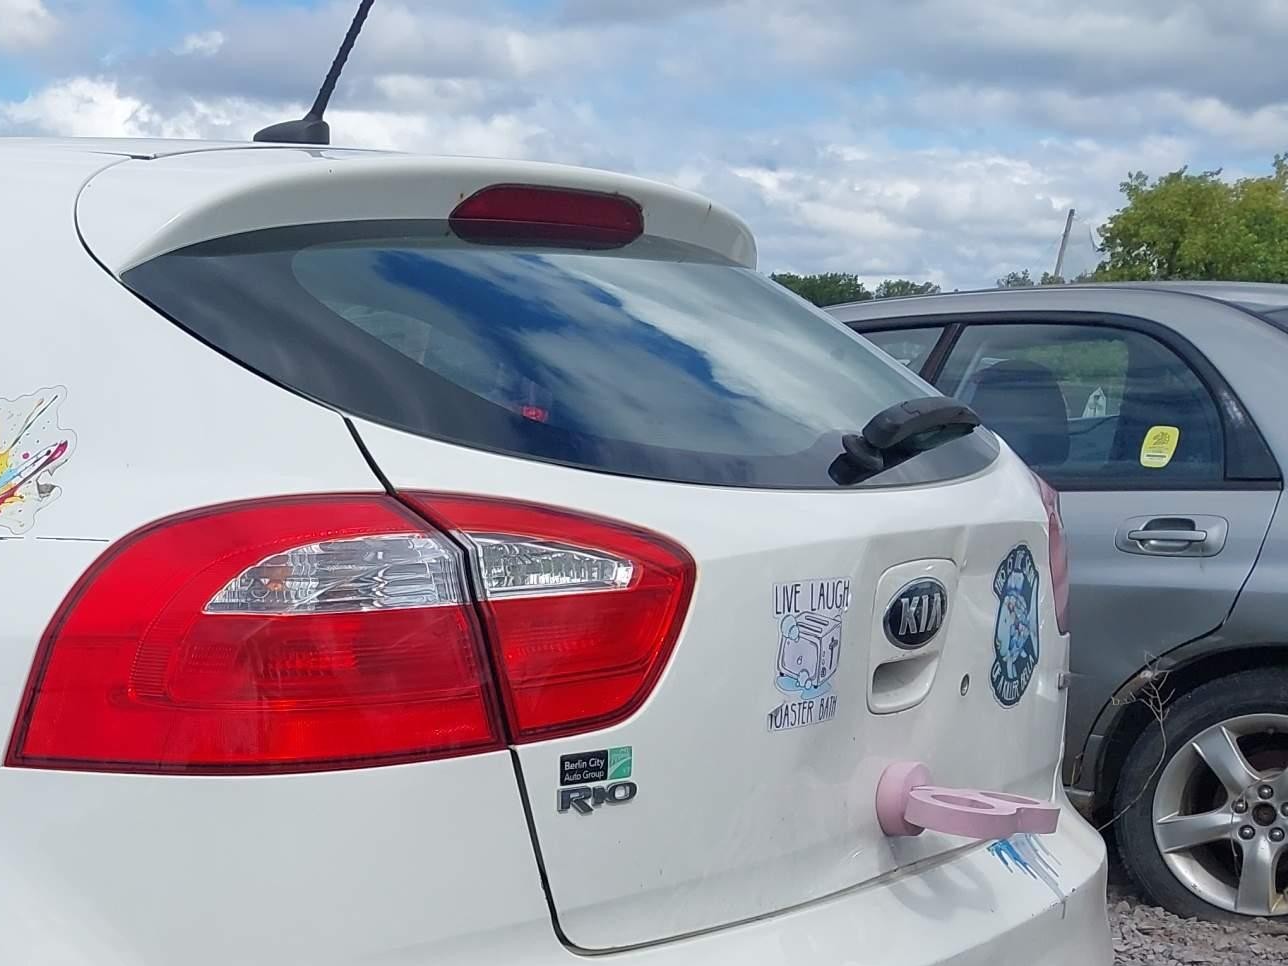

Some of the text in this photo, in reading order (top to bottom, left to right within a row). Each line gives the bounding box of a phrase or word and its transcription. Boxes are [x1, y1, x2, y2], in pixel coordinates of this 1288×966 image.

[775, 580, 850, 615] LIVE LAUGH
[898, 592, 943, 636] KIA
[818, 696, 838, 721] BATH
[564, 758, 605, 771] Berlin City
[564, 770, 605, 782] Auto Group
